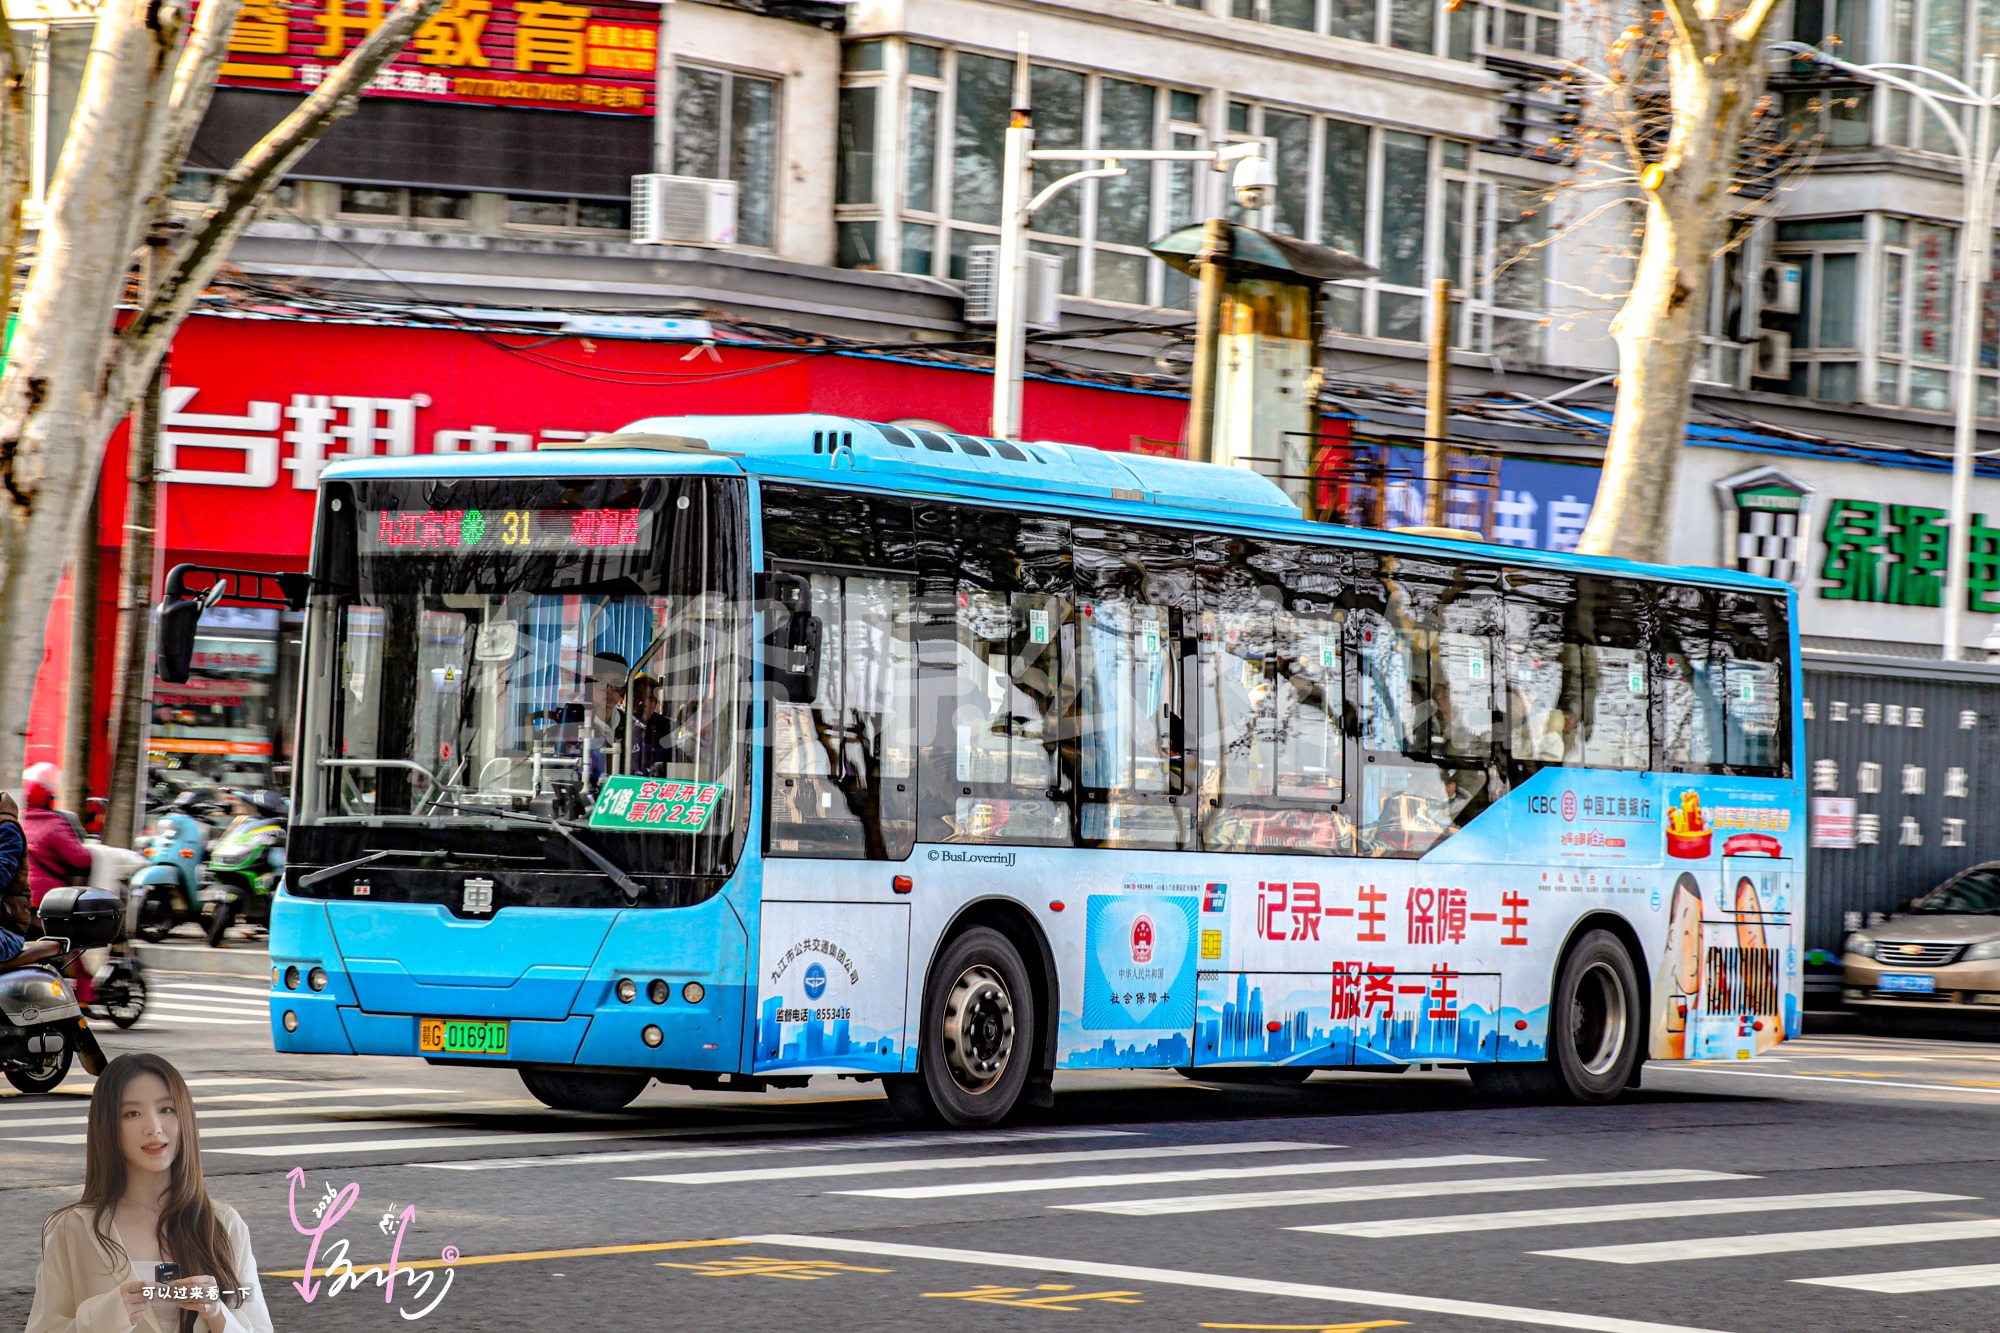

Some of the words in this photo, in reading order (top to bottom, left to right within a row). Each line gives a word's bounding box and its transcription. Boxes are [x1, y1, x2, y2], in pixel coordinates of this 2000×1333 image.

[502, 511, 531, 545] 31
[597, 787, 634, 816] 31路
[637, 781, 718, 804] 空调开启
[626, 802, 705, 824] 票价2元
[1527, 795, 1557, 814] ICBC
[1583, 795, 1651, 818] 中国工商银行
[1256, 881, 1387, 941] 记录一生
[1405, 887, 1530, 946] 保障一生
[771, 938, 859, 985] 九江市公共交通集团公司
[1118, 968, 1164, 980] 中华人民共和国
[1110, 993, 1170, 1005] 社会保障卡
[1330, 961, 1459, 1020] 服务一生
